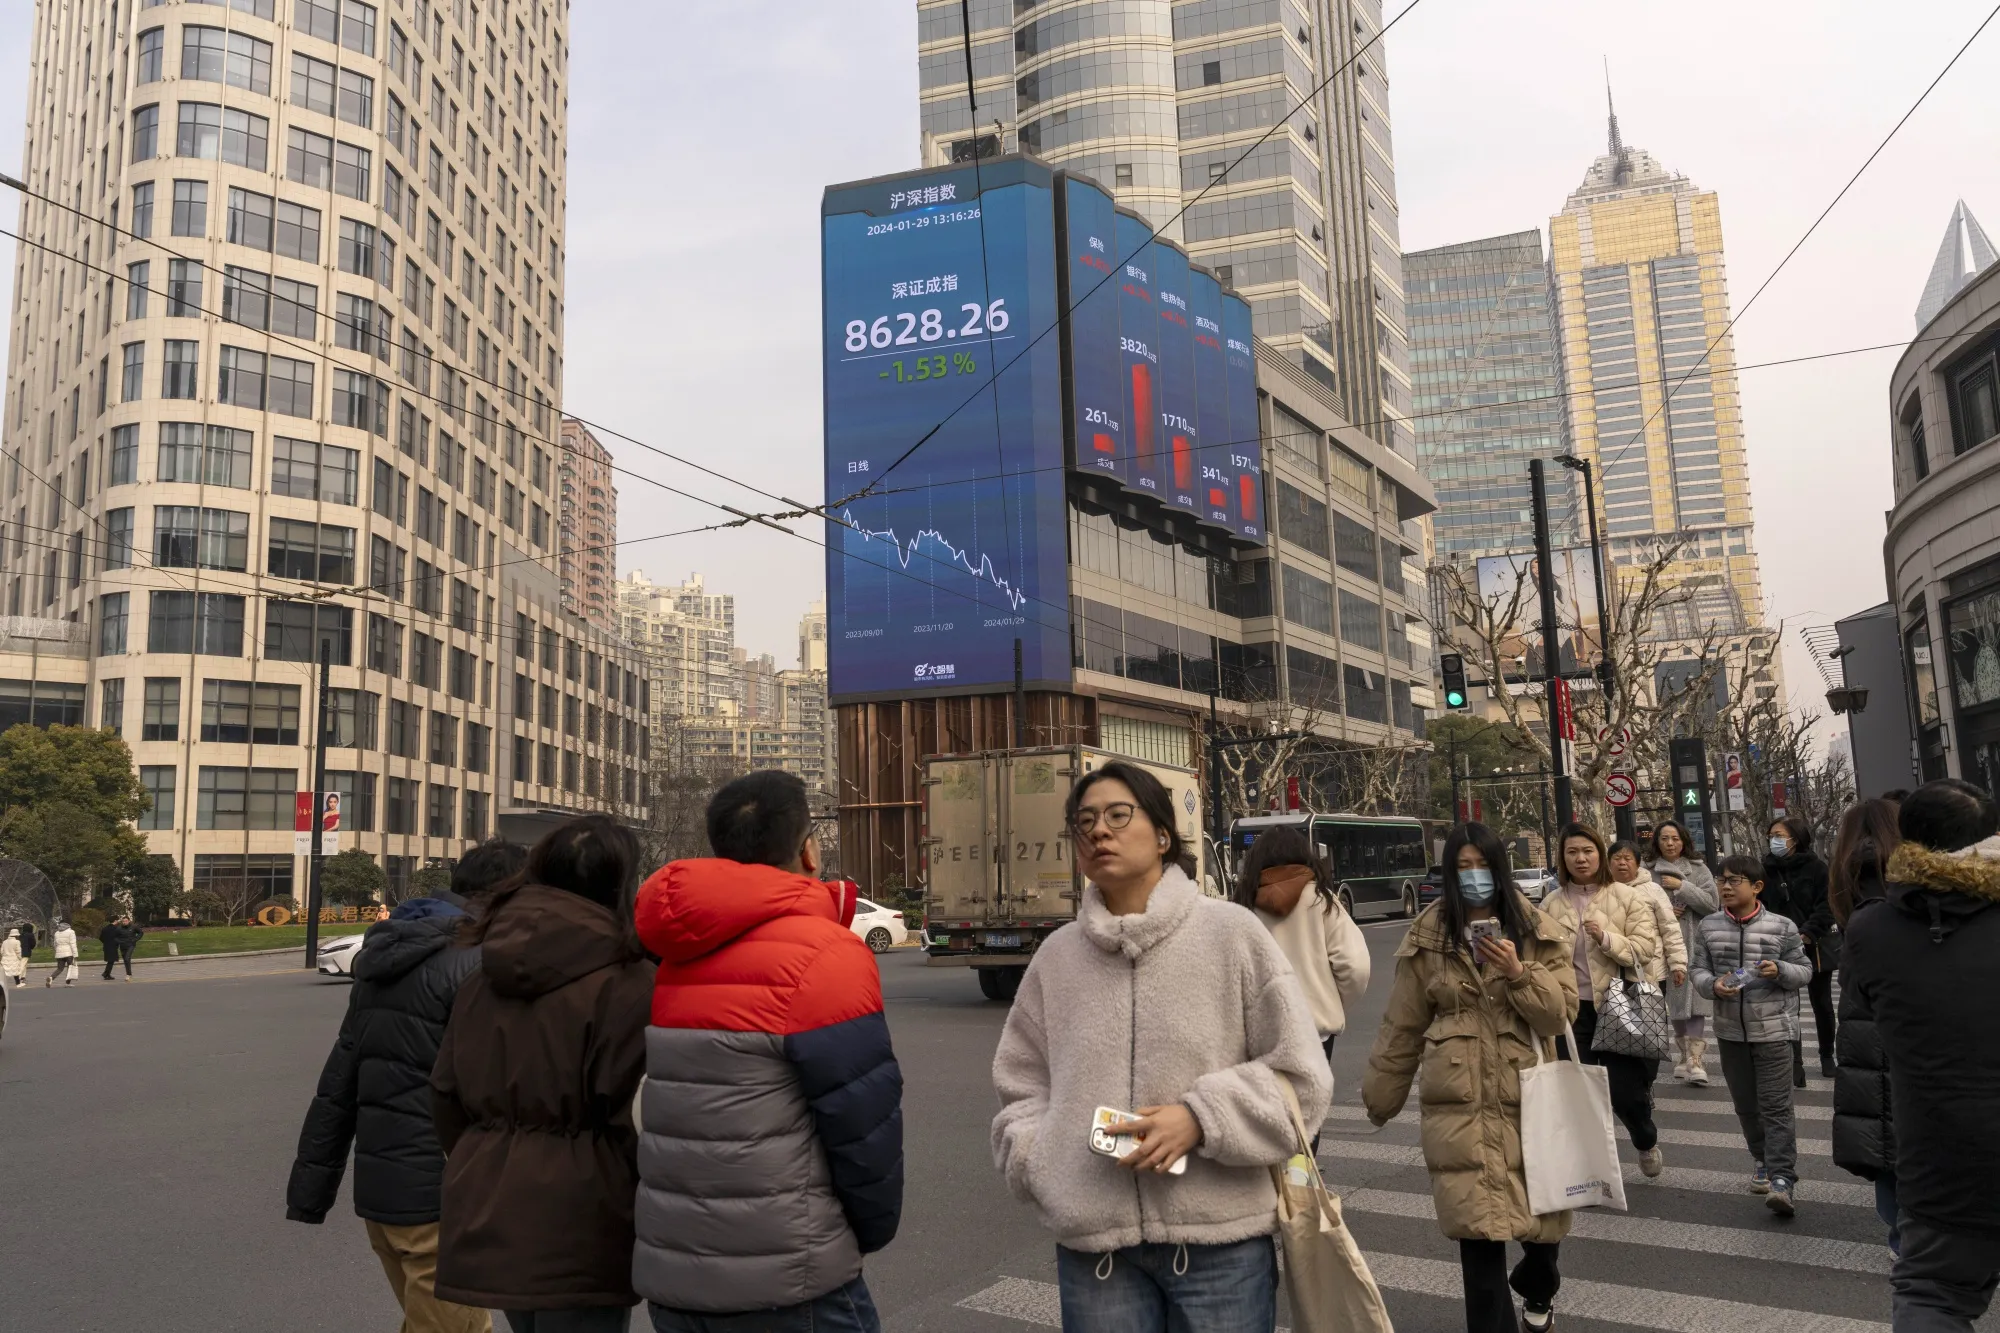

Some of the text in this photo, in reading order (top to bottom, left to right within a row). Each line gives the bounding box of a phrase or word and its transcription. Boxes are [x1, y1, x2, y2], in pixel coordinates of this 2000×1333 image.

[890, 183, 956, 210] 沪深指数
[867, 208, 981, 236] 2024-01-29 13:16:26
[1088, 236, 1105, 253] 保险
[1126, 265, 1148, 284] 银行类
[892, 274, 959, 300] 深证成指
[845, 298, 1010, 352] 8628.26
[848, 460, 870, 473] 日线
[1097, 458, 1115, 471] 成交量
[1139, 477, 1156, 490] 成交量
[1177, 495, 1193, 507] 成交量
[1212, 511, 1227, 522] 成交量
[1244, 525, 1258, 537] 成交量
[913, 623, 954, 633] 2023/11/20
[983, 617, 1025, 627] 2024/01/29
[845, 629, 884, 639] 2023/09/01
